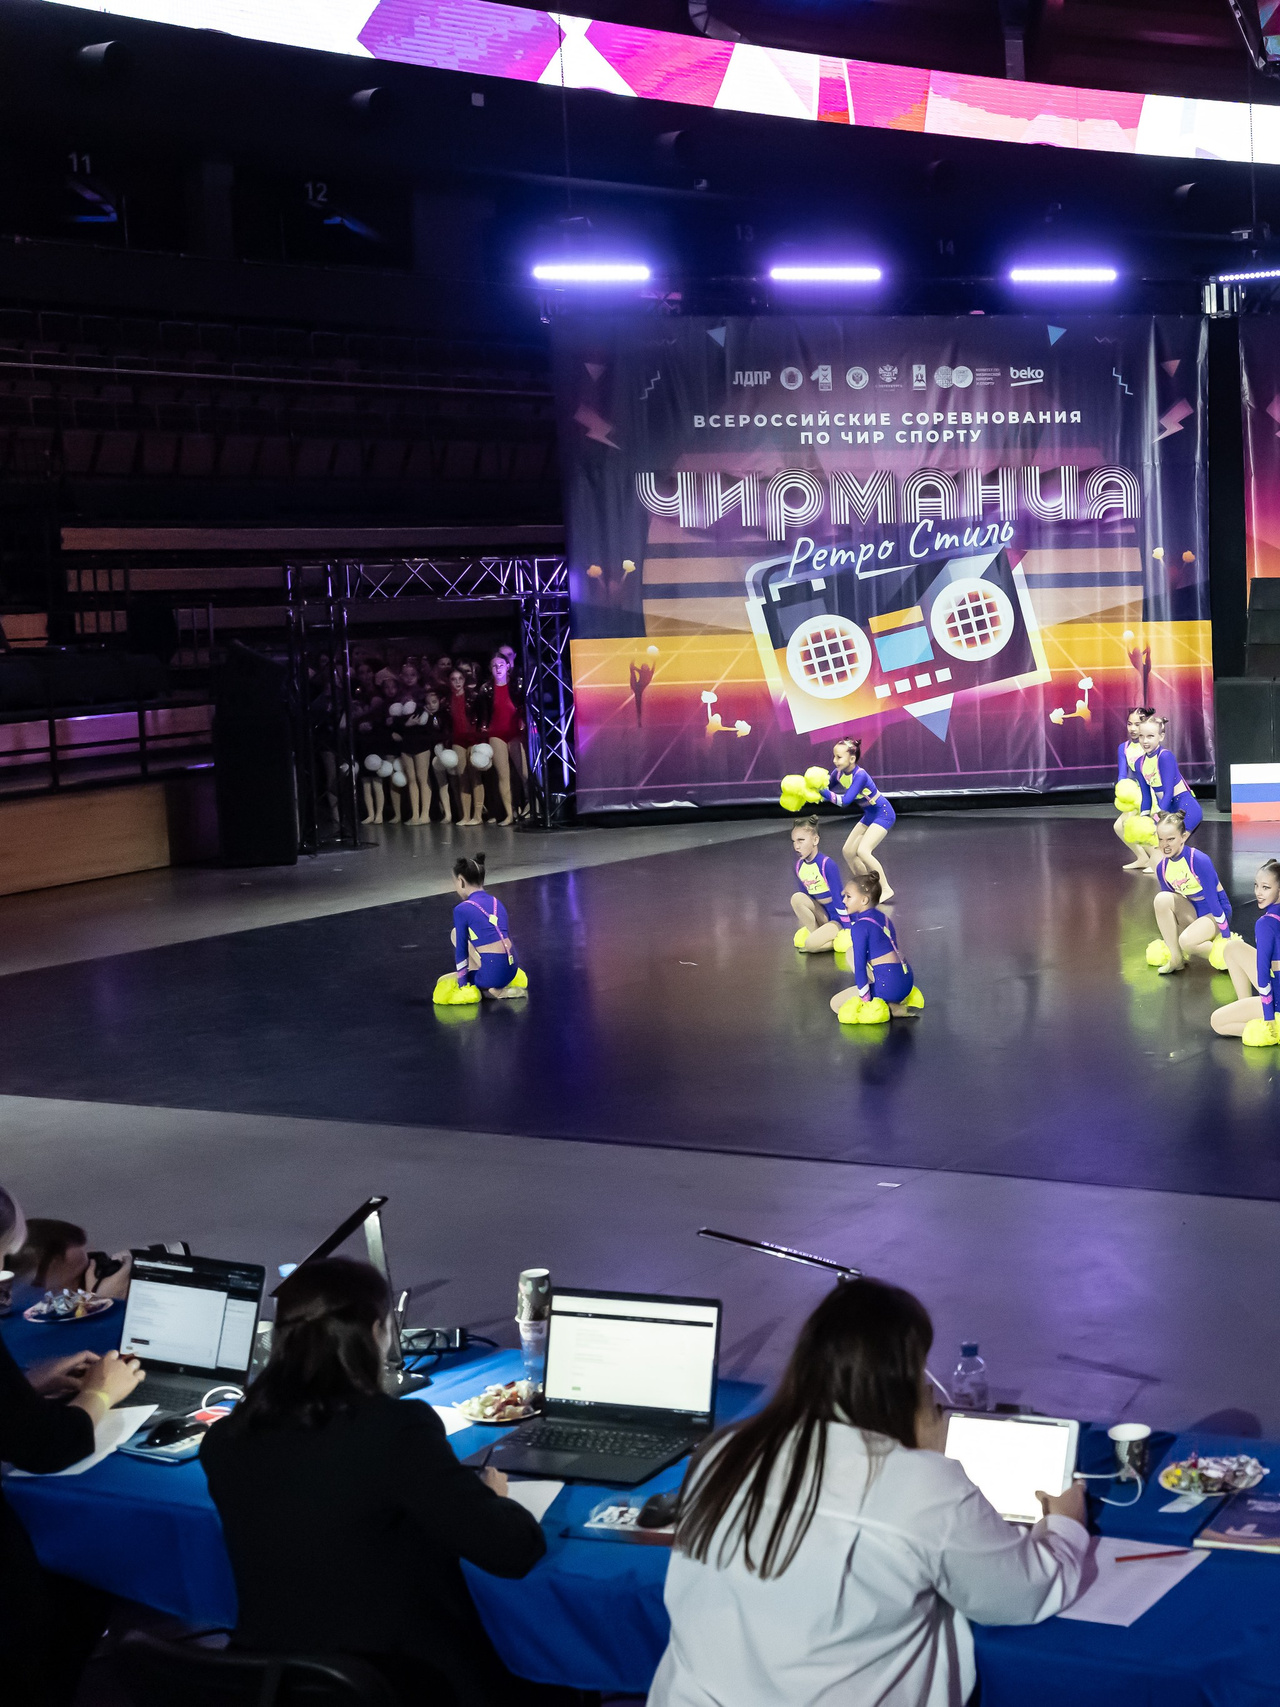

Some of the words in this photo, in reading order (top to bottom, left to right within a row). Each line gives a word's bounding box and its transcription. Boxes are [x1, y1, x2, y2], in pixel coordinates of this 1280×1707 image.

[68, 151, 91, 175] 11
[304, 182, 328, 203] 12
[733, 371, 771, 387] ЛДПР
[1010, 366, 1044, 379] beko
[694, 410, 892, 428] ВСЕРОССИЙСКИЕ
[901, 410, 1082, 426] СОРЕВНОВАНИЯ
[801, 430, 831, 445] ПО
[841, 430, 885, 444] ЧИР
[895, 428, 982, 444] СПОРТУ
[788, 536, 895, 579] Ретро
[909, 519, 1015, 557] Стиль
